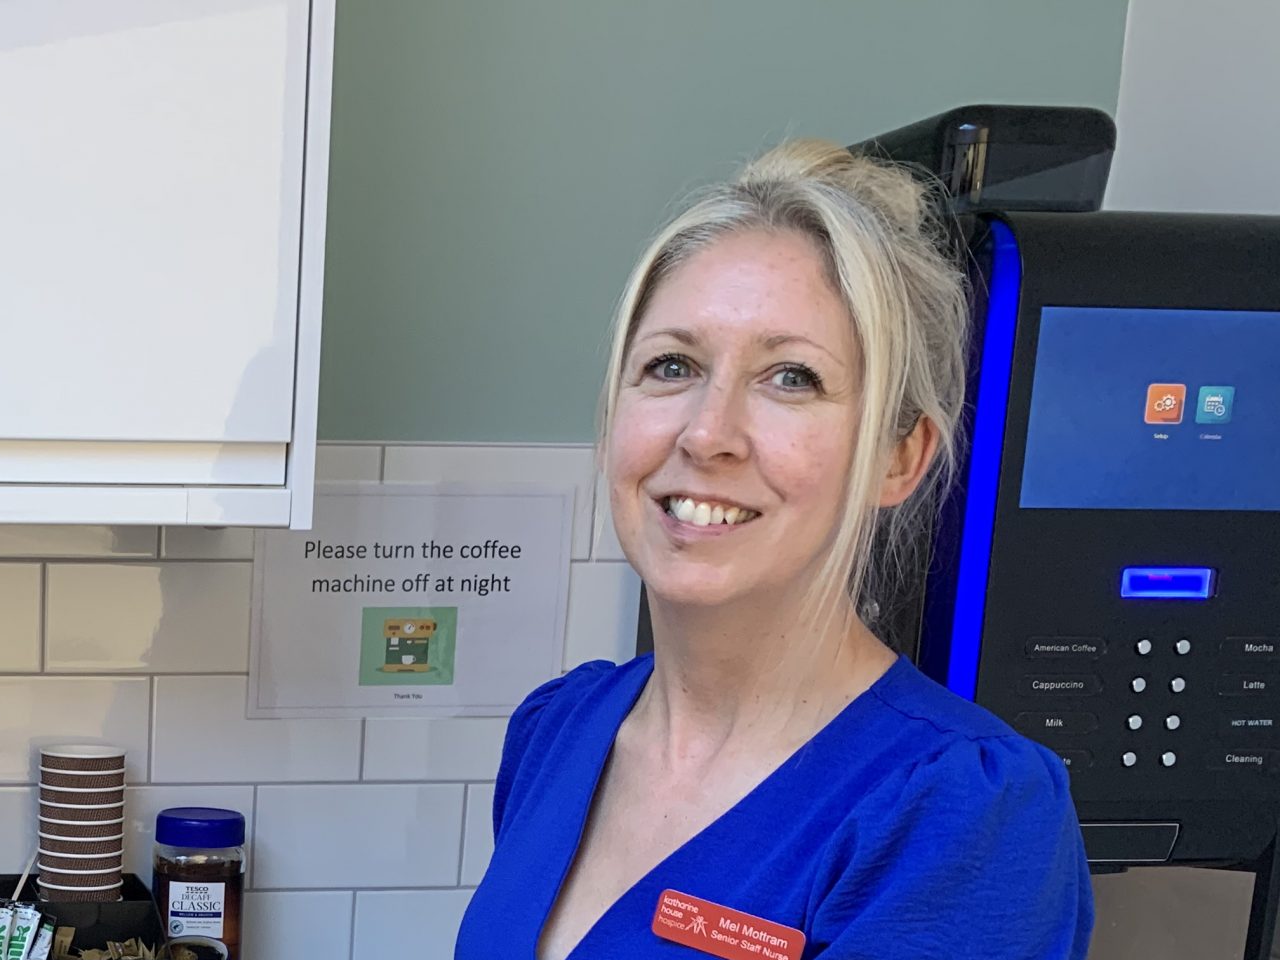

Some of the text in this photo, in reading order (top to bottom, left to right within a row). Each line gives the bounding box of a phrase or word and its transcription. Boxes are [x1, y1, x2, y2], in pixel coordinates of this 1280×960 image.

[304, 540, 522, 559] Please turn the coffee
[312, 573, 511, 596] machine off at night
[1034, 644, 1097, 652] American Coffee
[1245, 644, 1274, 652] Mocha
[1032, 681, 1084, 690] Cappuccino
[1243, 681, 1266, 689] Latte
[1045, 719, 1063, 727] Milk
[1225, 754, 1263, 764] Cleaning
[172, 901, 220, 911] CLASSIC
[663, 895, 699, 914] katharine
[661, 905, 683, 919] house
[658, 915, 685, 930] hospice
[718, 917, 788, 949] Mel Mottram
[8, 925, 31, 960] ilk
[710, 930, 739, 946] Senior
[740, 939, 762, 953] Staff
